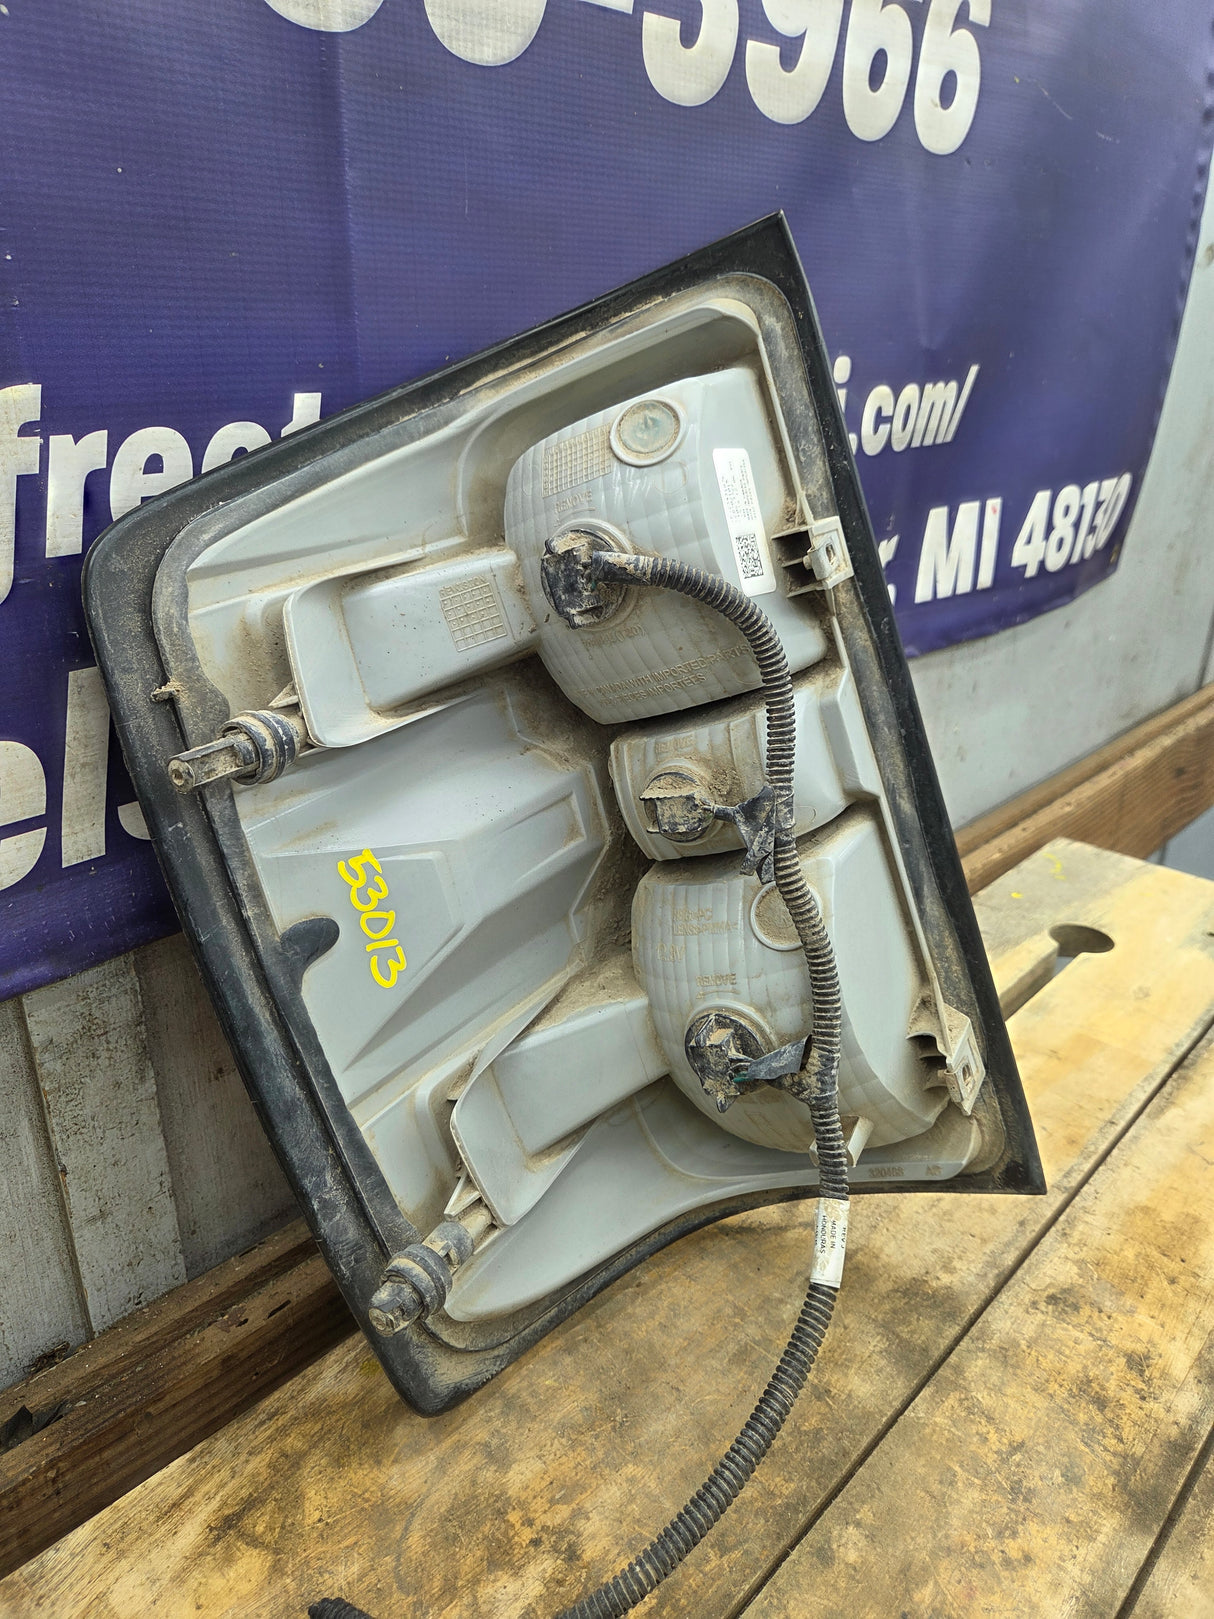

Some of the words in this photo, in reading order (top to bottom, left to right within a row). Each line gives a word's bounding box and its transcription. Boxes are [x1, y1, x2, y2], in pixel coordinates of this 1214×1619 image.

[914, 497, 1002, 604] MI
[1011, 472, 1132, 578] 48130
[627, 671, 652, 688] WITH
[650, 655, 708, 683] IMPORTED
[337, 848, 407, 989] 53013
[818, 1215, 828, 1254] HONDURAS
[829, 1219, 837, 1240] MADE
[829, 1240, 836, 1249] IN
